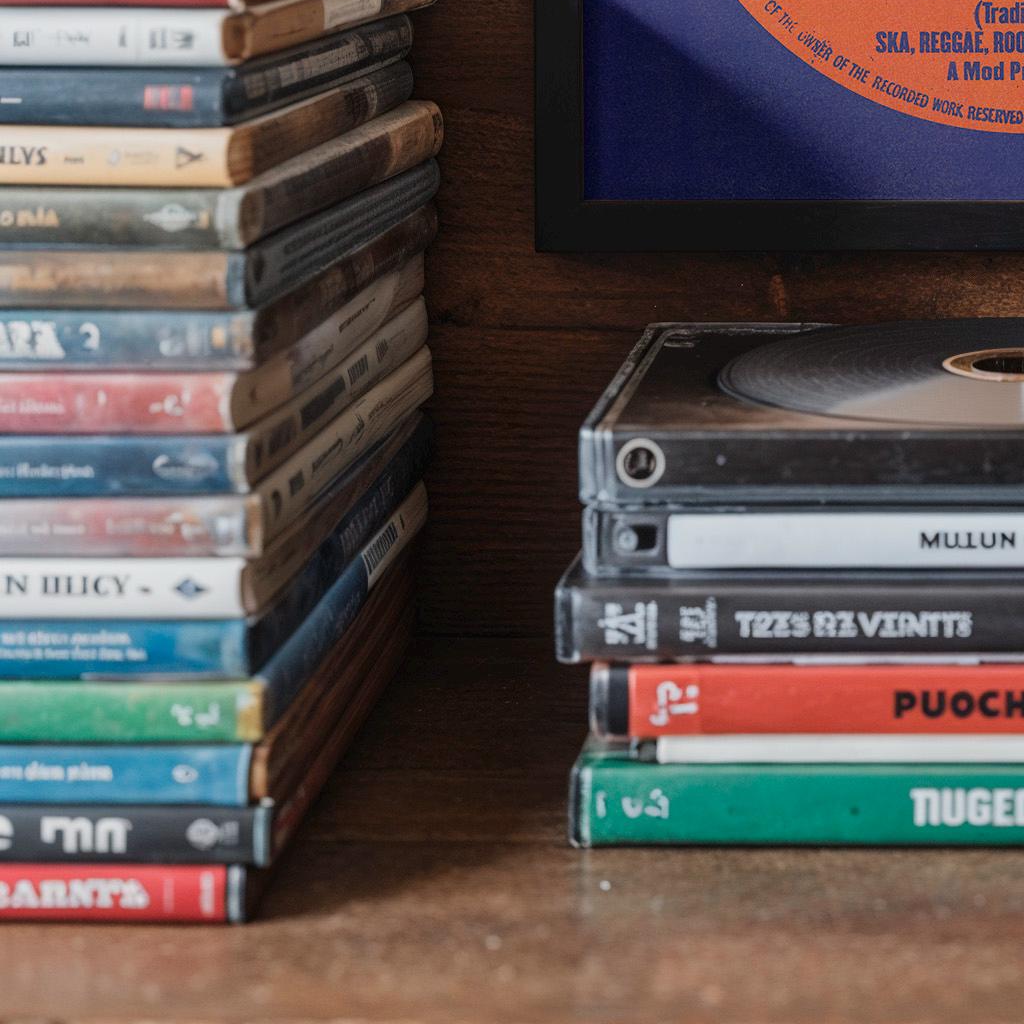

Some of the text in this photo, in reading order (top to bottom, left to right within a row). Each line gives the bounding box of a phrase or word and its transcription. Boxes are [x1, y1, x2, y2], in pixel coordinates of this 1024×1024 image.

[876, 31, 915, 55] SKA,
[920, 31, 989, 55] REGGAE,
[947, 61, 958, 80] A
[964, 61, 1004, 80] Mod
[833, 55, 850, 70] OF
[848, 63, 870, 84] THE
[872, 76, 929, 108] RECORDED
[932, 97, 963, 118] WORK
[967, 106, 1024, 124] RESERVED
